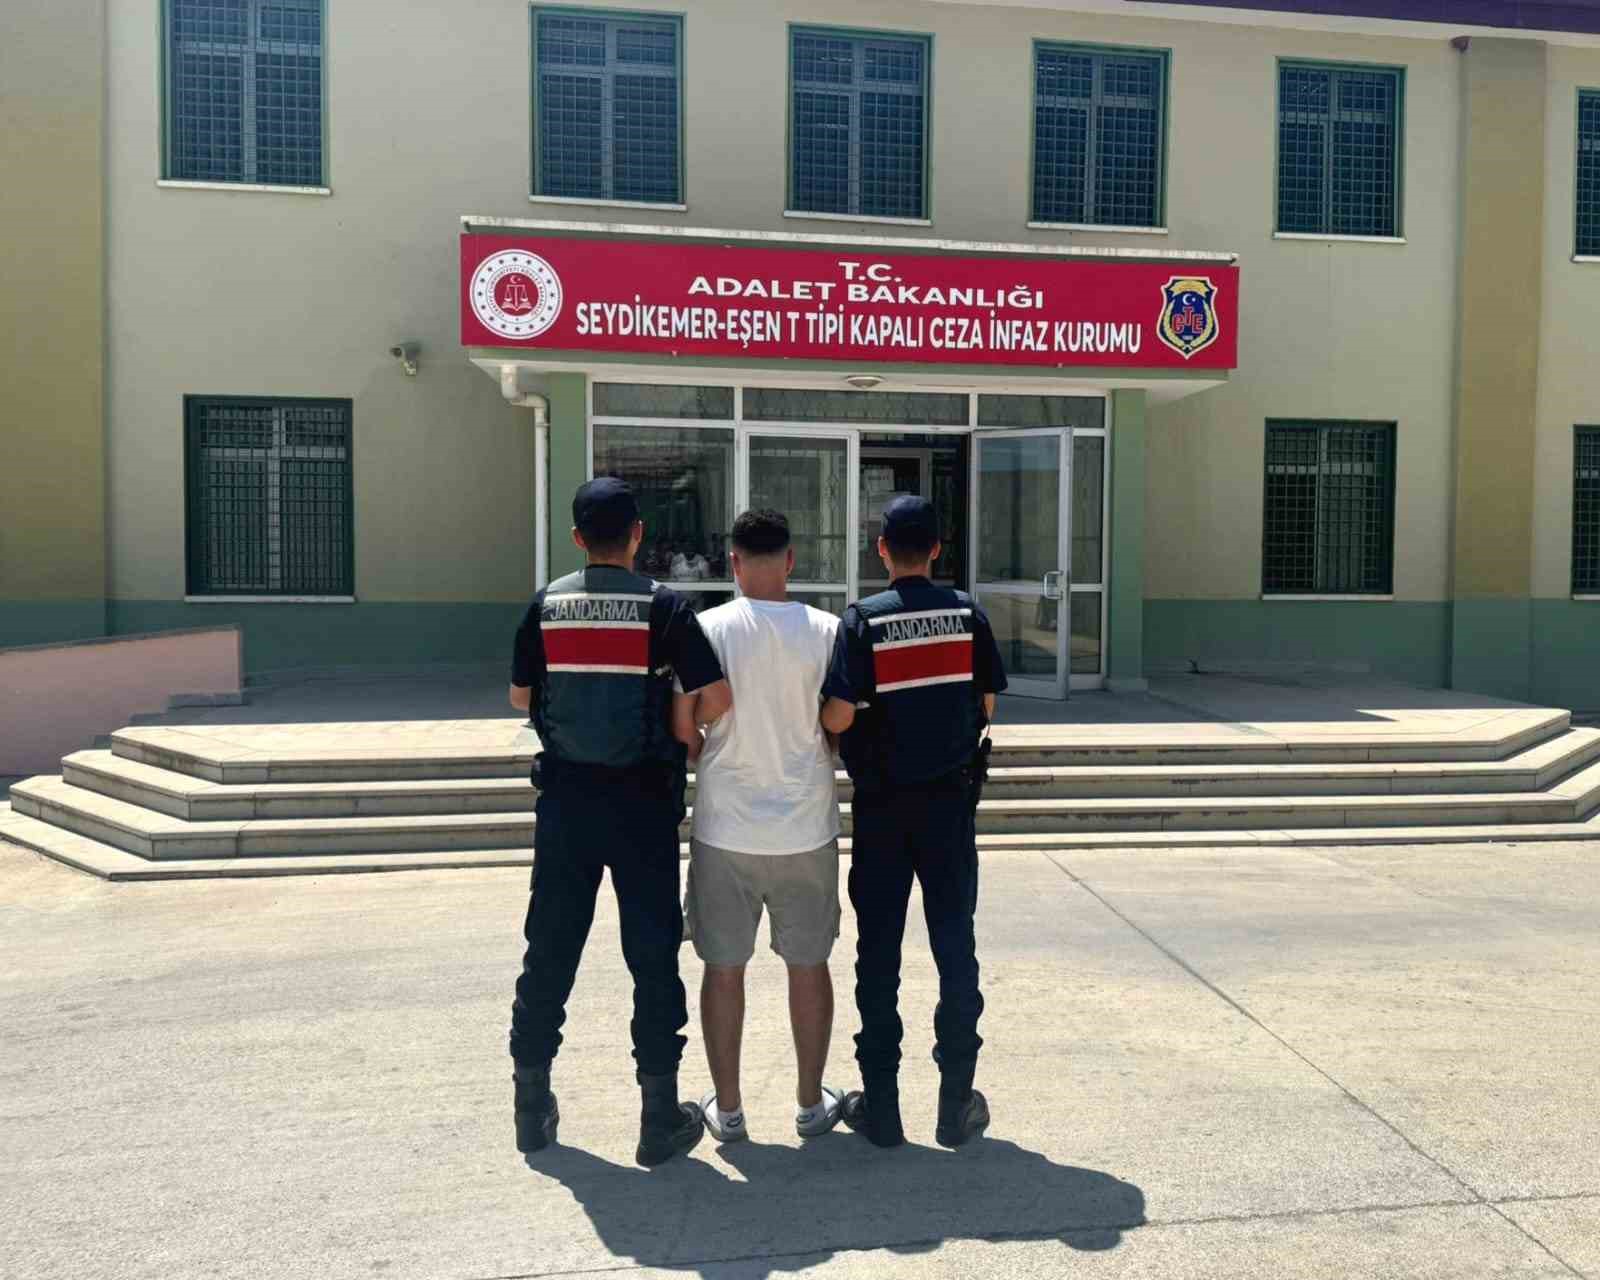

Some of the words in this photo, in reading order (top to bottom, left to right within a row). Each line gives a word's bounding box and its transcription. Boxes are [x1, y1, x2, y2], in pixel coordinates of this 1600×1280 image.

[838, 261, 902, 283] T.C.
[687, 276, 836, 301] ADALET
[847, 283, 1044, 309] BAKANLIĞI
[575, 294, 781, 349] SEYDİKEMER-EŞEN
[786, 311, 800, 343] T
[805, 303, 844, 345] TİPİ
[850, 314, 924, 347] KAPALI
[929, 317, 984, 349] CEZA
[989, 309, 1049, 351] İNFAZ
[1054, 321, 1141, 354] KURUMU
[550, 599, 640, 621] JANDARMA
[882, 615, 966, 642] JANDARMA
